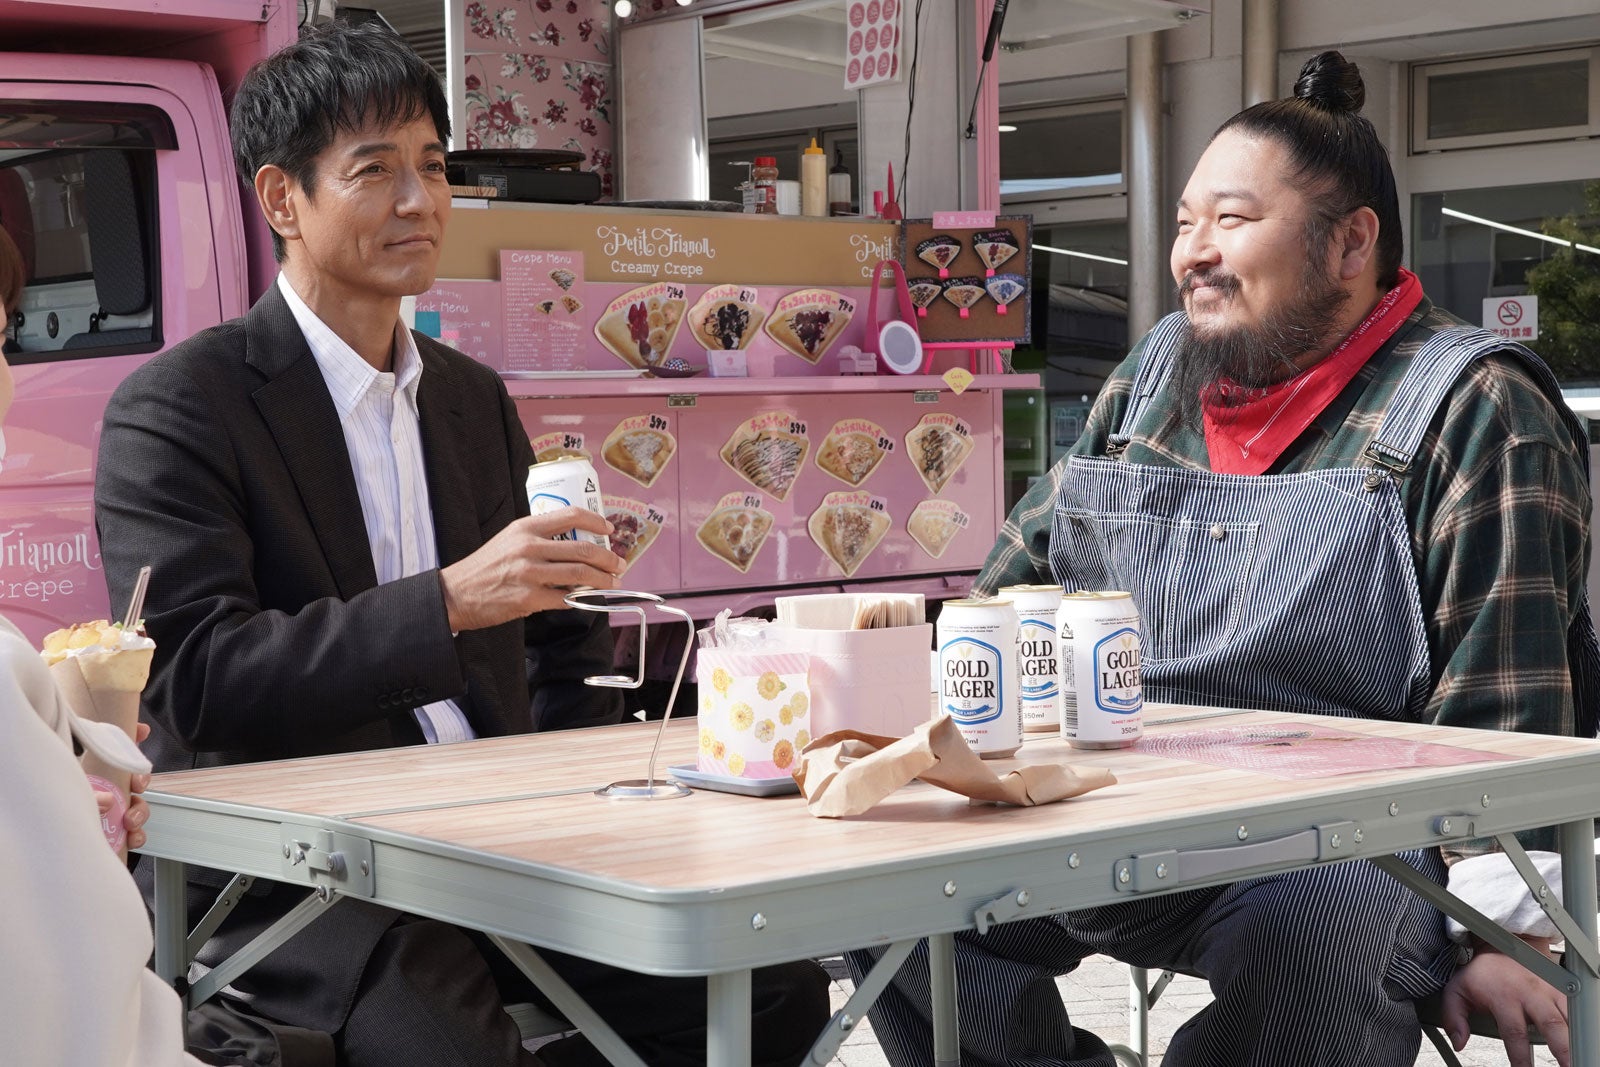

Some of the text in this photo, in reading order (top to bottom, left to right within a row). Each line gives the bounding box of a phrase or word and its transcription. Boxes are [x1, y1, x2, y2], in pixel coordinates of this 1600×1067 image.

[597, 226, 716, 259] Petit Trianon
[850, 234, 899, 263] Petit
[511, 252, 572, 265] Crepe Menu
[611, 260, 704, 278] Creamy Crepe
[861, 266, 895, 278] Cram
[667, 286, 684, 299] 740
[415, 301, 470, 313] rink Menu
[649, 415, 667, 430] 590
[790, 422, 806, 434] 590
[878, 437, 894, 451] 590
[744, 496, 761, 508] 640
[647, 508, 664, 524] 740
[952, 511, 968, 526] 590
[0, 580, 74, 602] repe
[1021, 640, 1053, 658] OLD
[1107, 649, 1140, 670] GOLD
[946, 660, 990, 678] GOLD
[1022, 658, 1058, 677] GER
[944, 680, 996, 699] LAGER
[1121, 726, 1138, 735] 350ml
